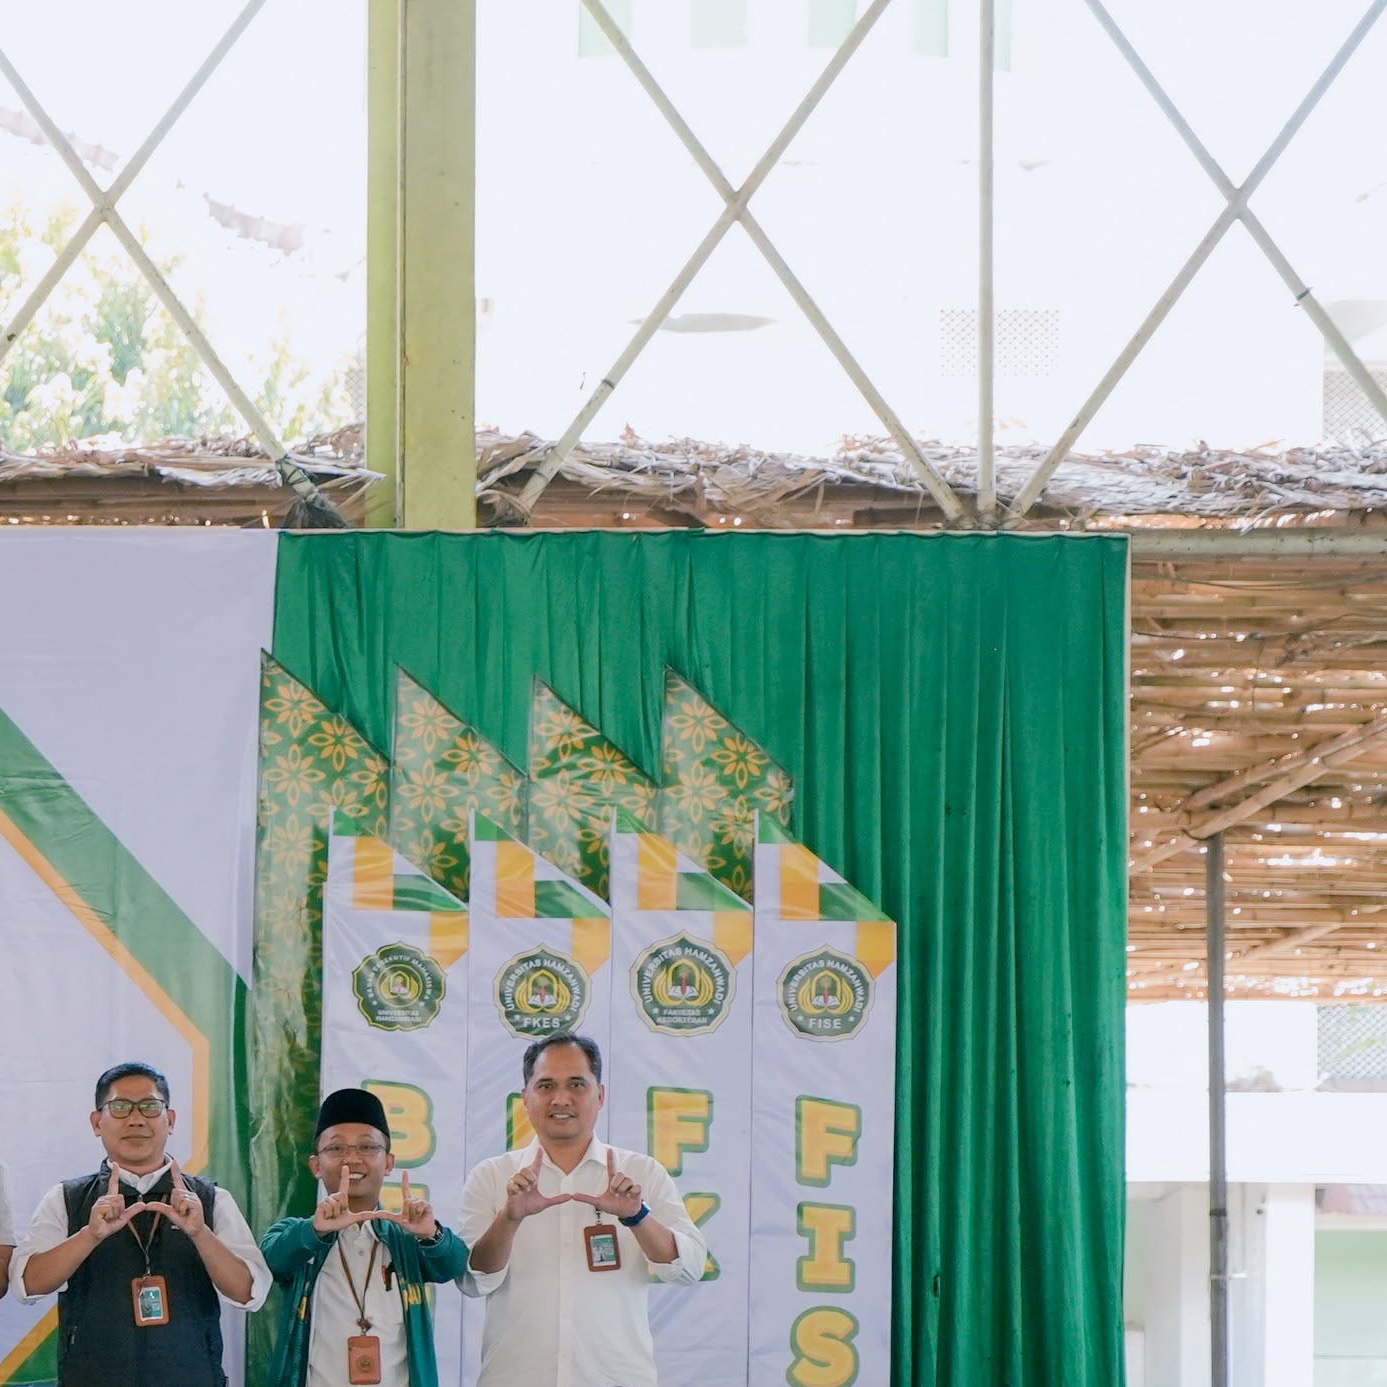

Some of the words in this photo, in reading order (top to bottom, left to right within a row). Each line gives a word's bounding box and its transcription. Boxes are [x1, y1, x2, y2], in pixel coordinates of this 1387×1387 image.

[505, 959, 542, 1011] UNIVERSITAS
[543, 959, 581, 1012] HAMZANWADI
[642, 946, 682, 1004] UNIVERSITAS
[684, 946, 726, 1005] HAMZANWADI
[787, 959, 825, 1012] UNIVERSITAS
[827, 959, 865, 1013] HAMZANWADI
[523, 1017, 561, 1029] FKES
[663, 1008, 702, 1016] FAKULTAS
[808, 1018, 842, 1029] FISE
